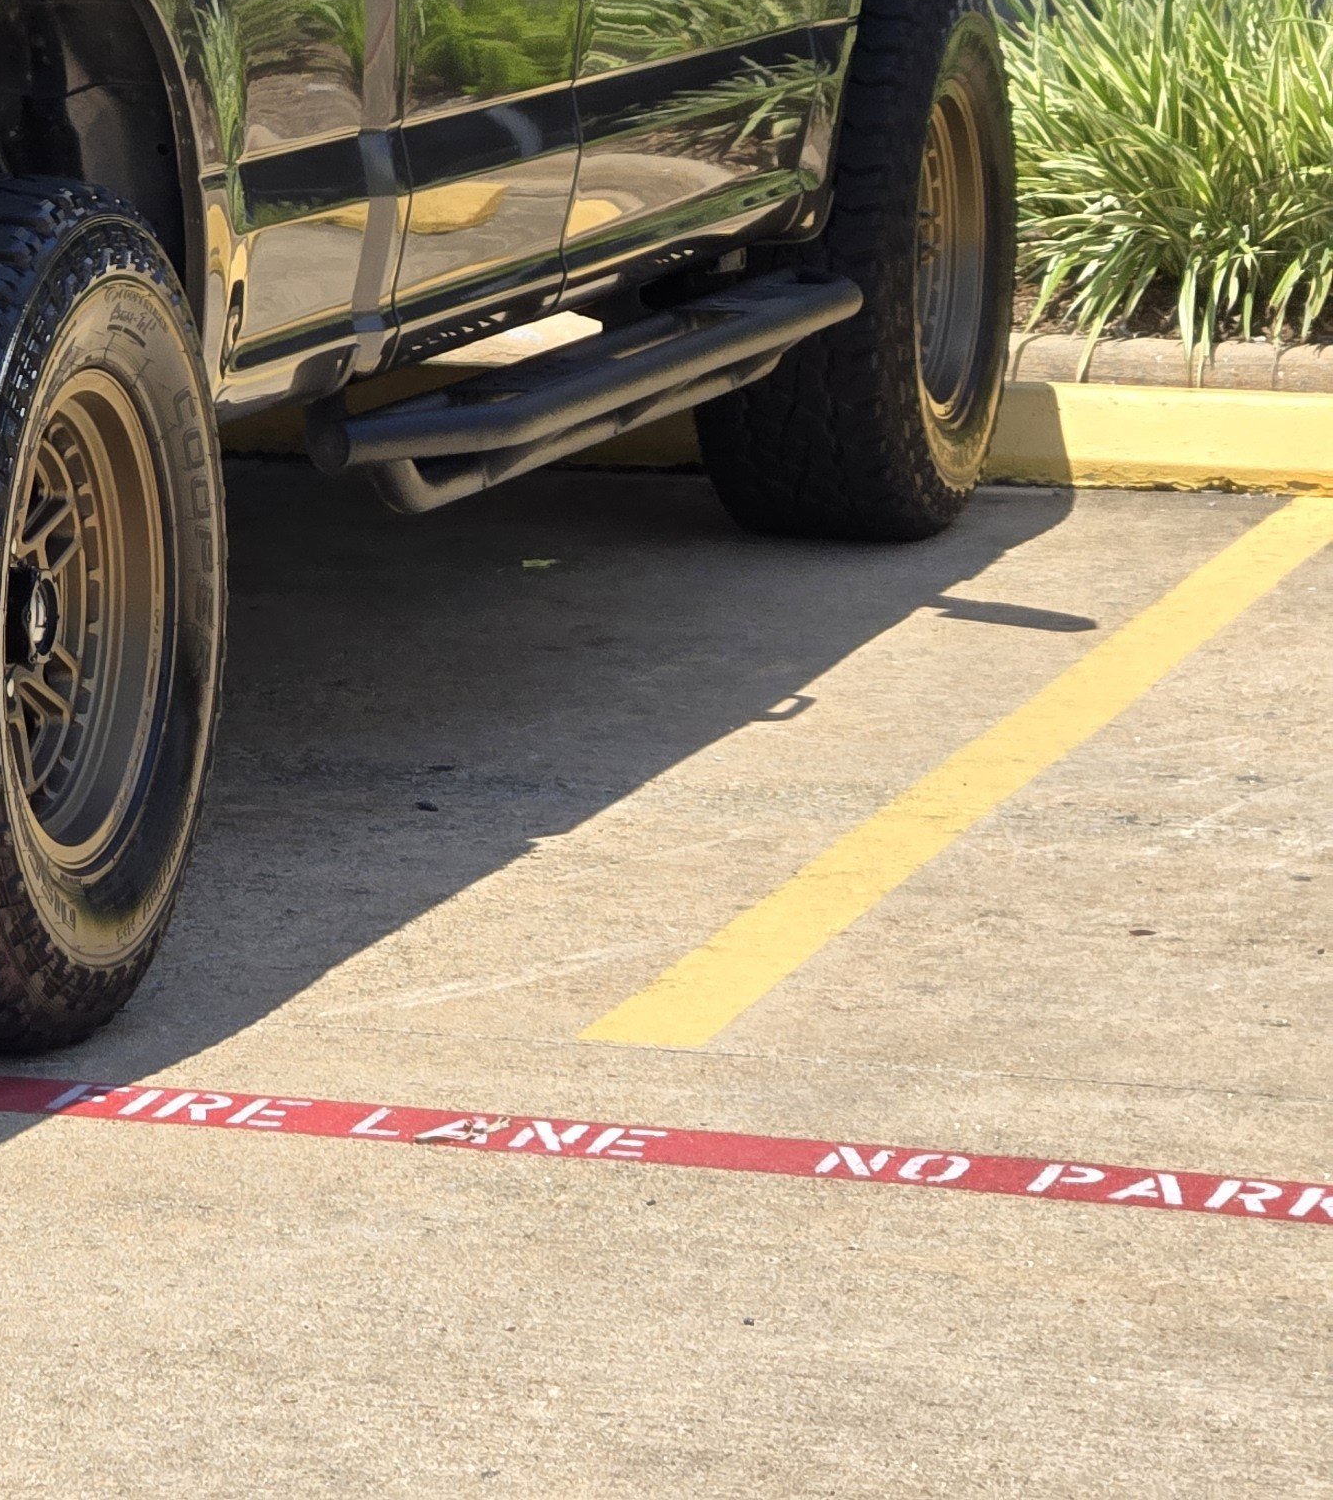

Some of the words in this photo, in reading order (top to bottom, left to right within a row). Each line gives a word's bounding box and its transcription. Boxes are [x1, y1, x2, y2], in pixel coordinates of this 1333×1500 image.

[46, 1084, 313, 1128] FIRE
[348, 1105, 669, 1158] LANE
[814, 1145, 973, 1183] NO
